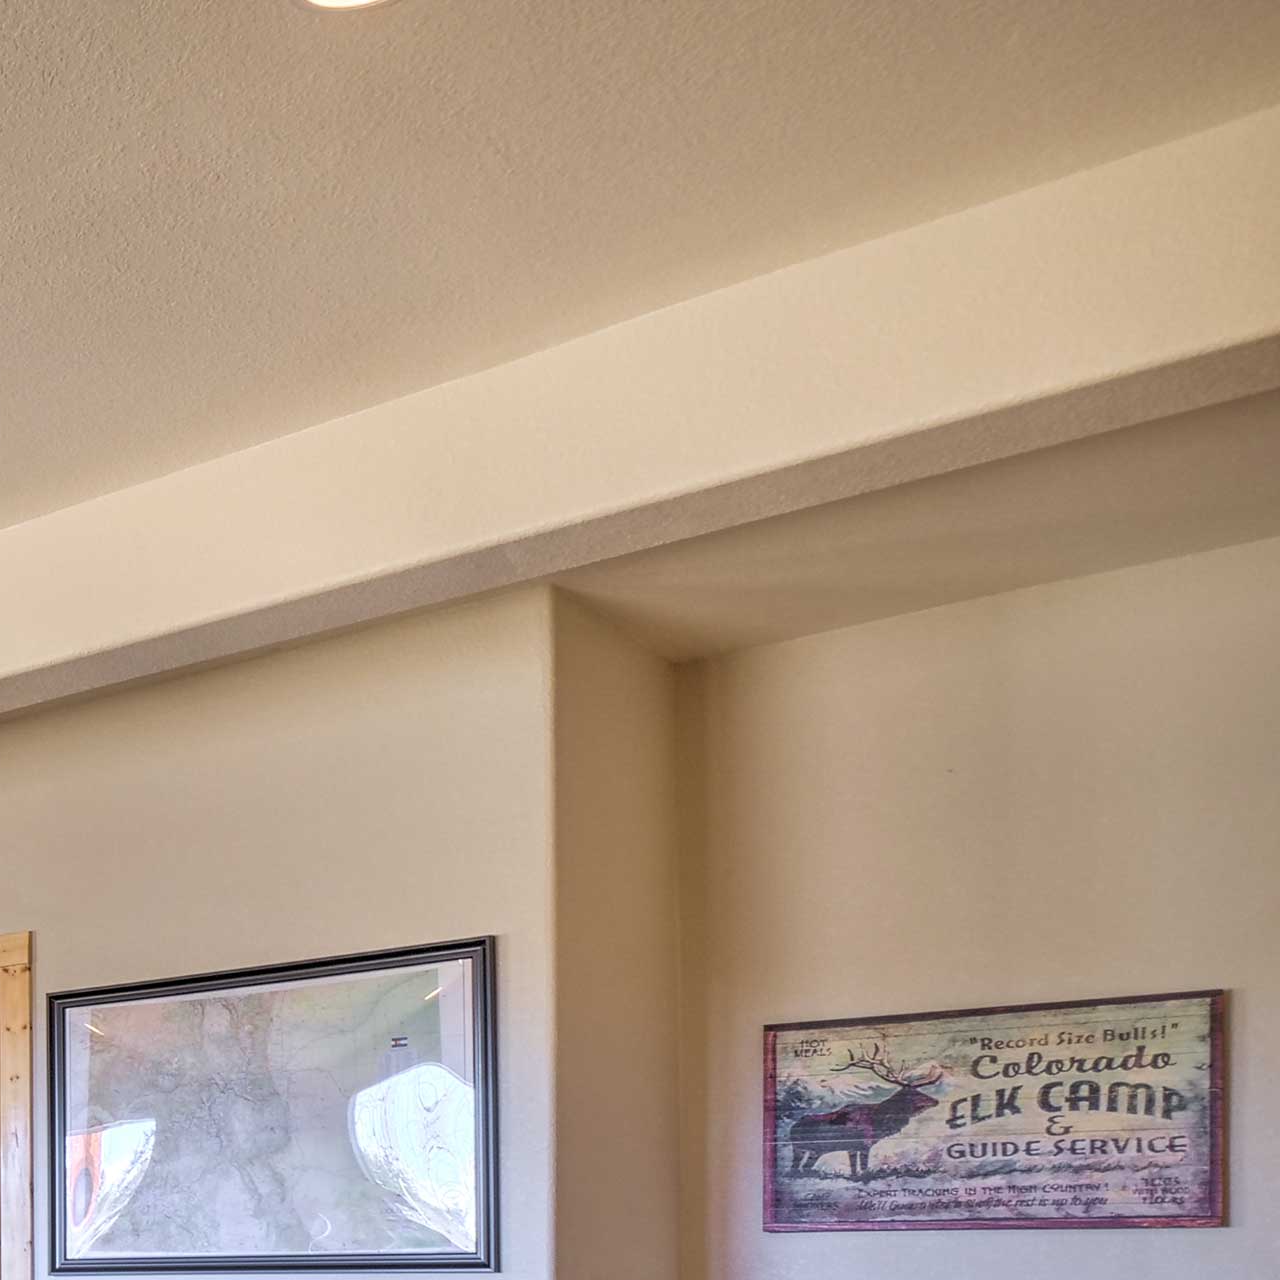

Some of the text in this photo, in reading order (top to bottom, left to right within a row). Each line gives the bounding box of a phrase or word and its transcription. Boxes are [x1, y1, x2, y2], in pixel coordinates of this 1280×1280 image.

[970, 1033, 1049, 1052] "Record
[1056, 1031, 1095, 1047] Size
[969, 1045, 1177, 1080] Colorado
[945, 1079, 1188, 1130] ELK CAMP
[1045, 1114, 1074, 1137] &
[946, 1135, 1188, 1160] GUIDE SERVICE
[857, 1188, 898, 1198] EXPERT
[964, 1187, 977, 1196] IN
[981, 1185, 1004, 1195] THE
